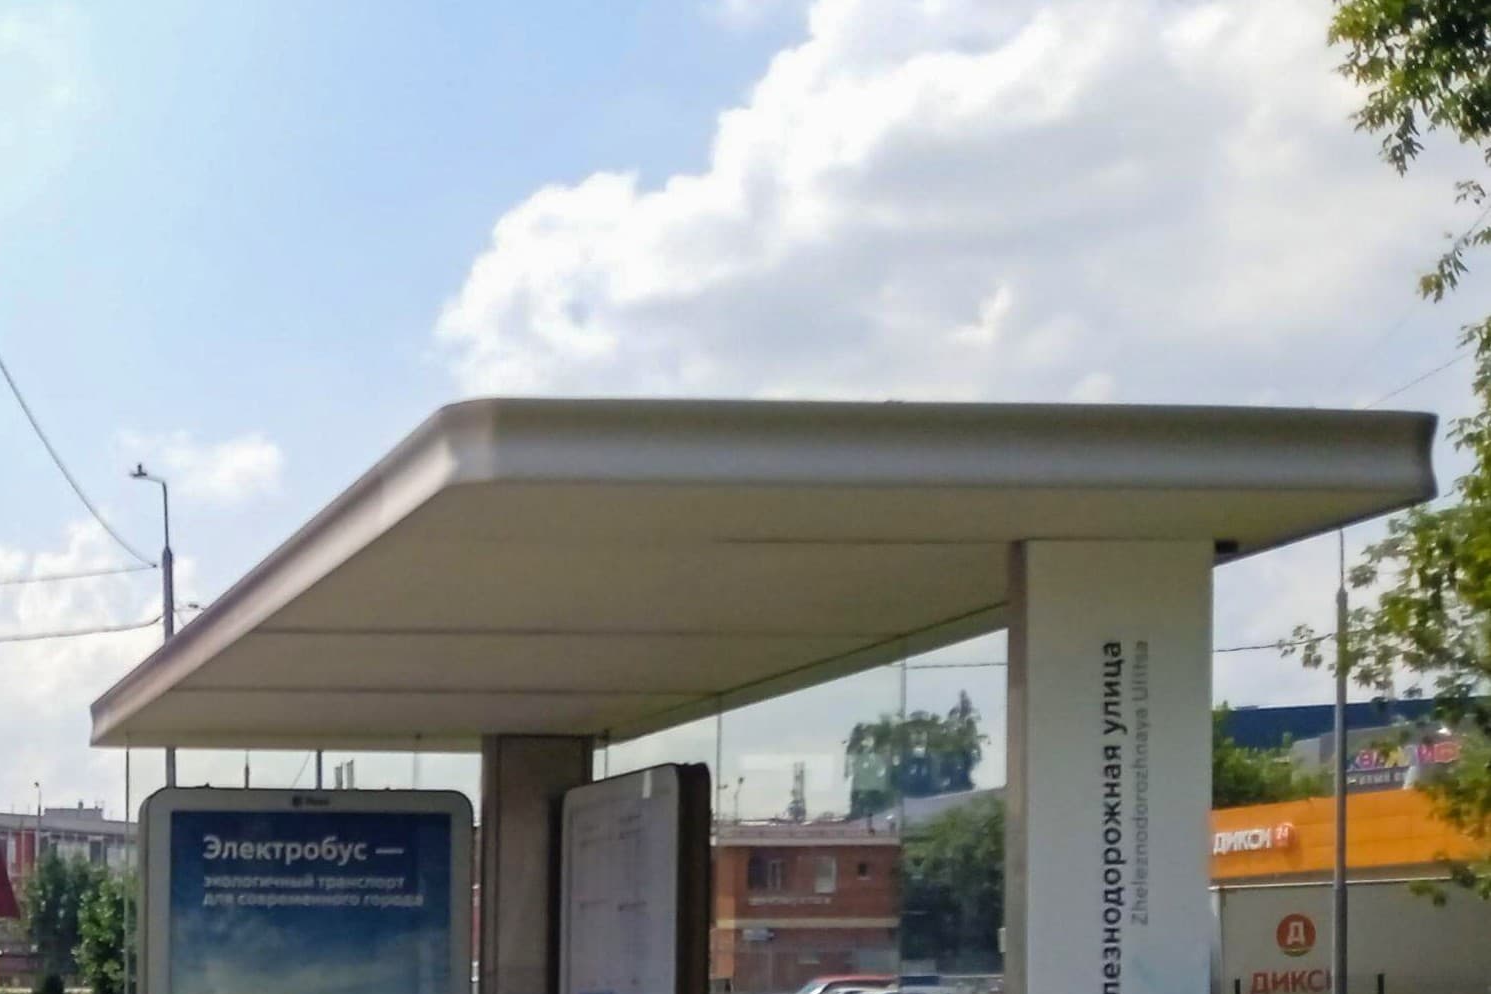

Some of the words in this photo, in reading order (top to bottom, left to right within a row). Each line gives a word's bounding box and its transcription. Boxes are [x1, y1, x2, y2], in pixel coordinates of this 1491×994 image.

[1104, 641, 1128, 735] улица
[1132, 640, 1148, 701] Ulitsa
[1131, 707, 1149, 925] Zheleznodorozhnaya
[203, 835, 367, 866] Электробус
[1213, 829, 1271, 855] ДИКСИ
[318, 876, 404, 891] транспорт
